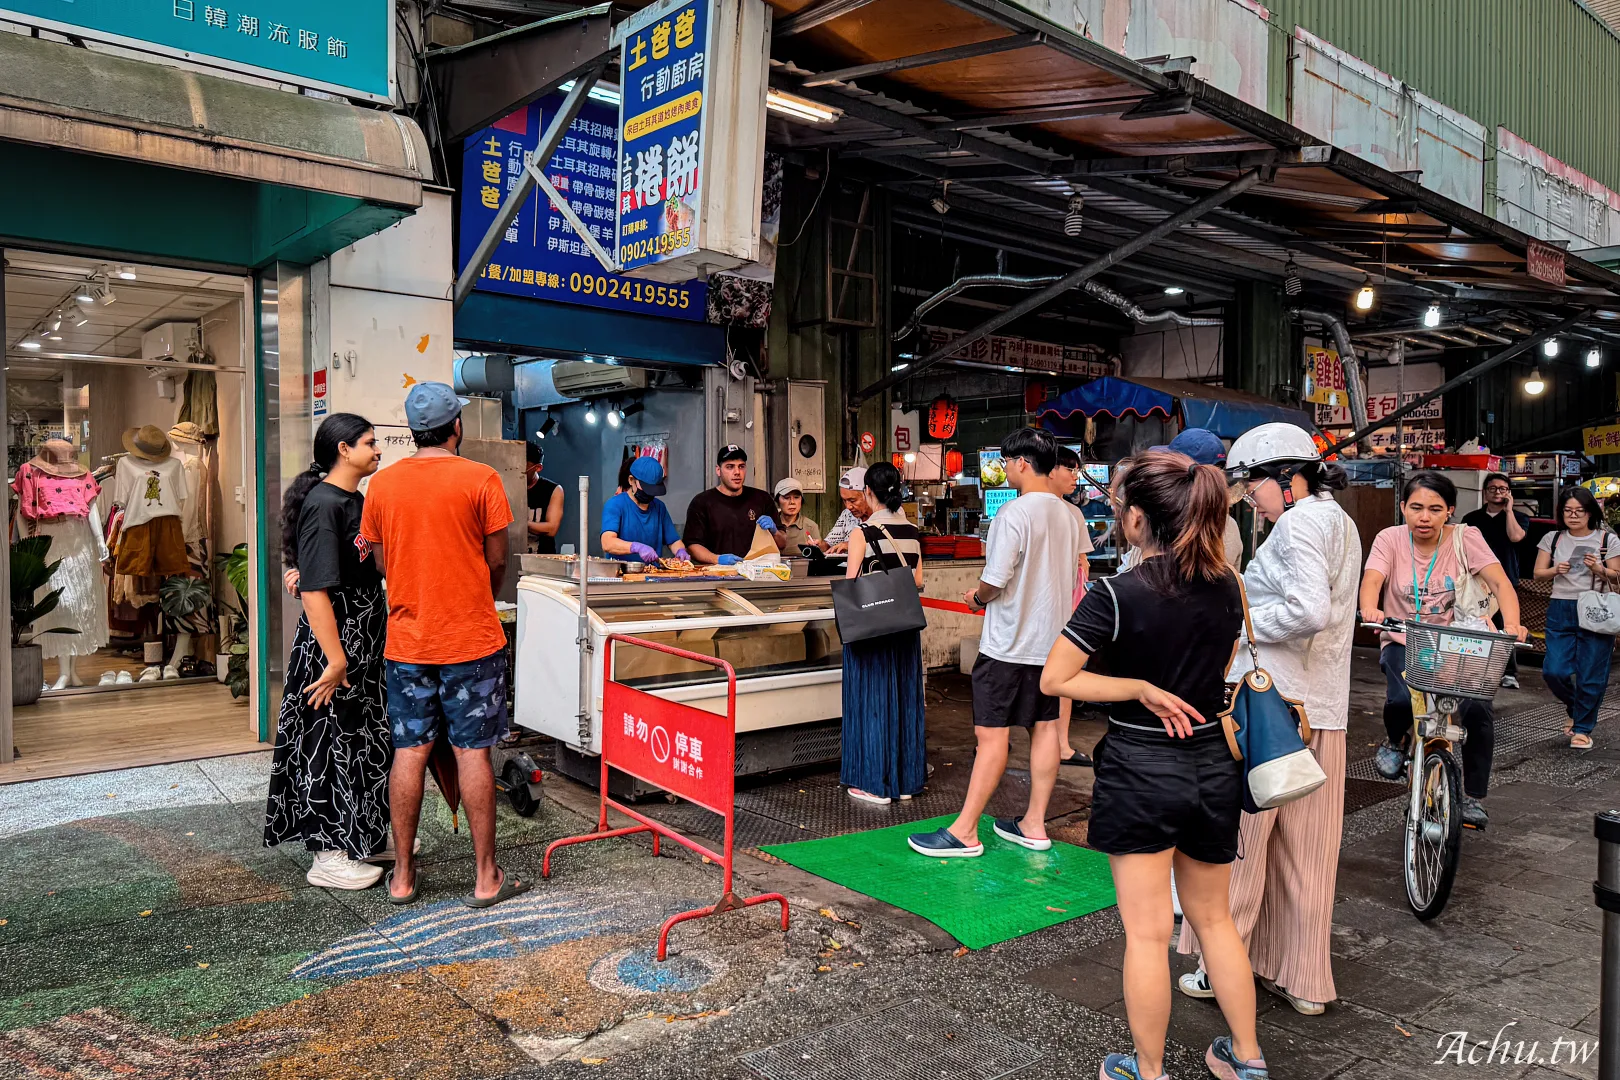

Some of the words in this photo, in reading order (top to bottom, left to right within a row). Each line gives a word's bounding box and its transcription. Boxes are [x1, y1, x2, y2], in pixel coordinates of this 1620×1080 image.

[174, 0, 349, 59] 日韓潮流服飾
[628, 8, 696, 72] 土爸爸
[640, 52, 705, 102] 行動廚房
[569, 117, 619, 141] 耳其招牌
[626, 96, 699, 136] 來自土耳其道地烤肉美食
[480, 136, 503, 209] 土爸爸
[621, 153, 633, 215] 土耳其
[634, 129, 700, 211] 捲餅
[548, 216, 614, 241] 伊斯堡羊
[571, 200, 617, 222] 帶骨碳烤
[620, 227, 691, 264] 0902419555
[569, 272, 690, 310] 0902419555
[895, 425, 911, 451] 包
[623, 712, 649, 744] 請勿
[674, 731, 704, 763] 停車
[672, 757, 704, 780] 謝謝合作
